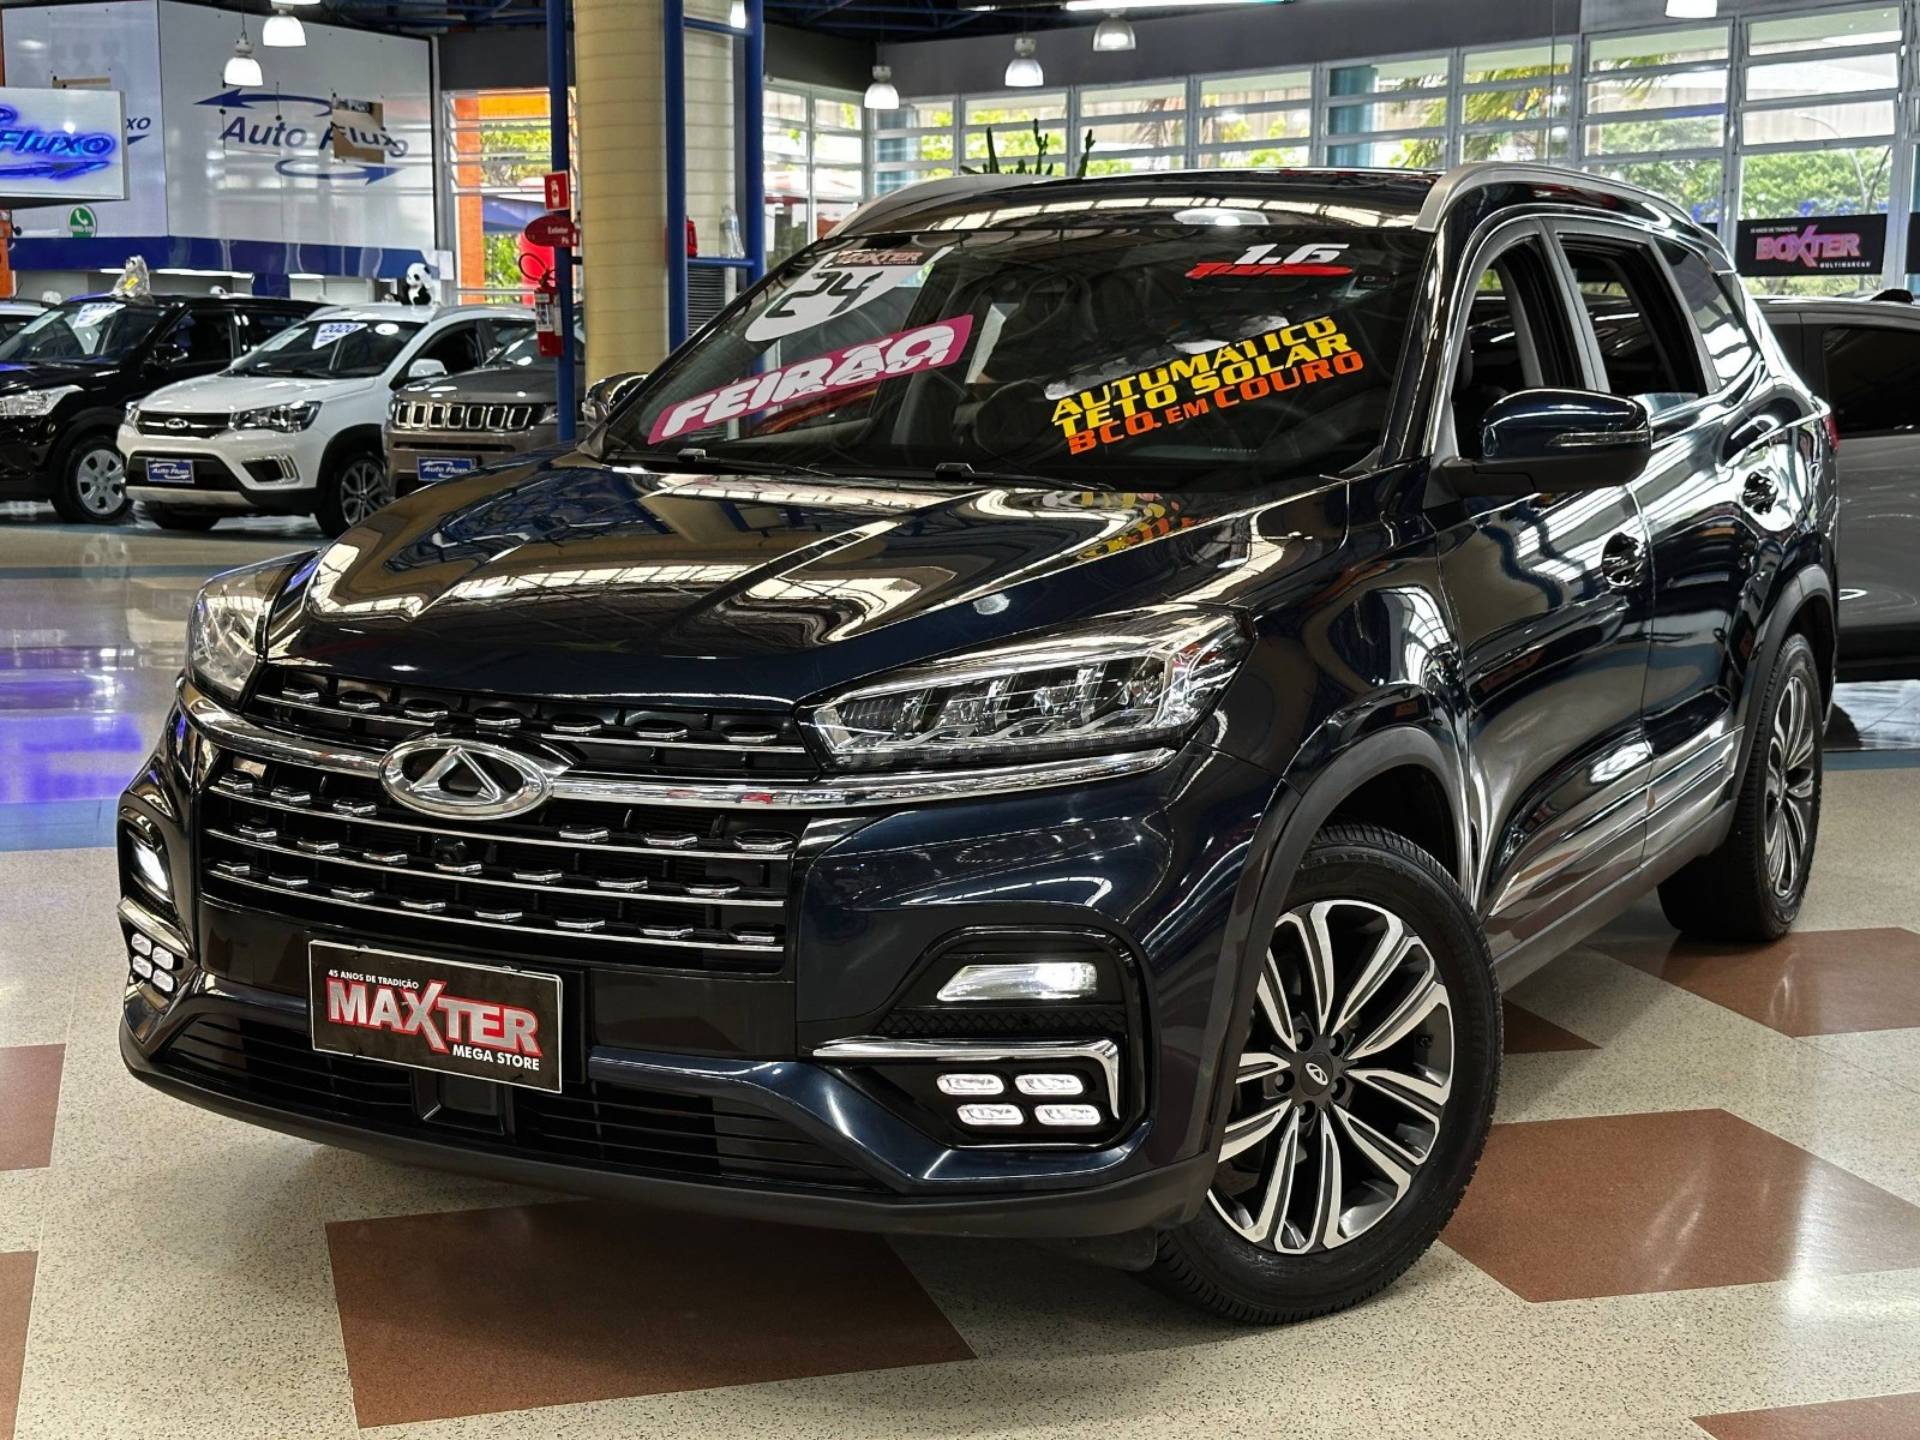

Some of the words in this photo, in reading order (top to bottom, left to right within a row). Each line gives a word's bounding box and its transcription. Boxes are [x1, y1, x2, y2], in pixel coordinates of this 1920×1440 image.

[0, 128, 113, 155] Fluxo
[219, 116, 307, 148] Auto
[1234, 243, 1350, 265] 1.6
[1755, 225, 1861, 268] BOXTER
[765, 270, 884, 318] 24
[1054, 384, 1178, 438] TETO
[1191, 333, 1353, 396] SOLAR
[1164, 398, 1210, 425] EM
[1214, 350, 1364, 409] COURO
[328, 968, 339, 978] 45
[340, 970, 365, 982] ANOS
[365, 974, 377, 984] DE
[377, 976, 420, 990] TRADIÇÃO
[326, 979, 543, 1055] MAXTER
[452, 1044, 494, 1065] MEGA
[496, 1051, 541, 1072] STORE
